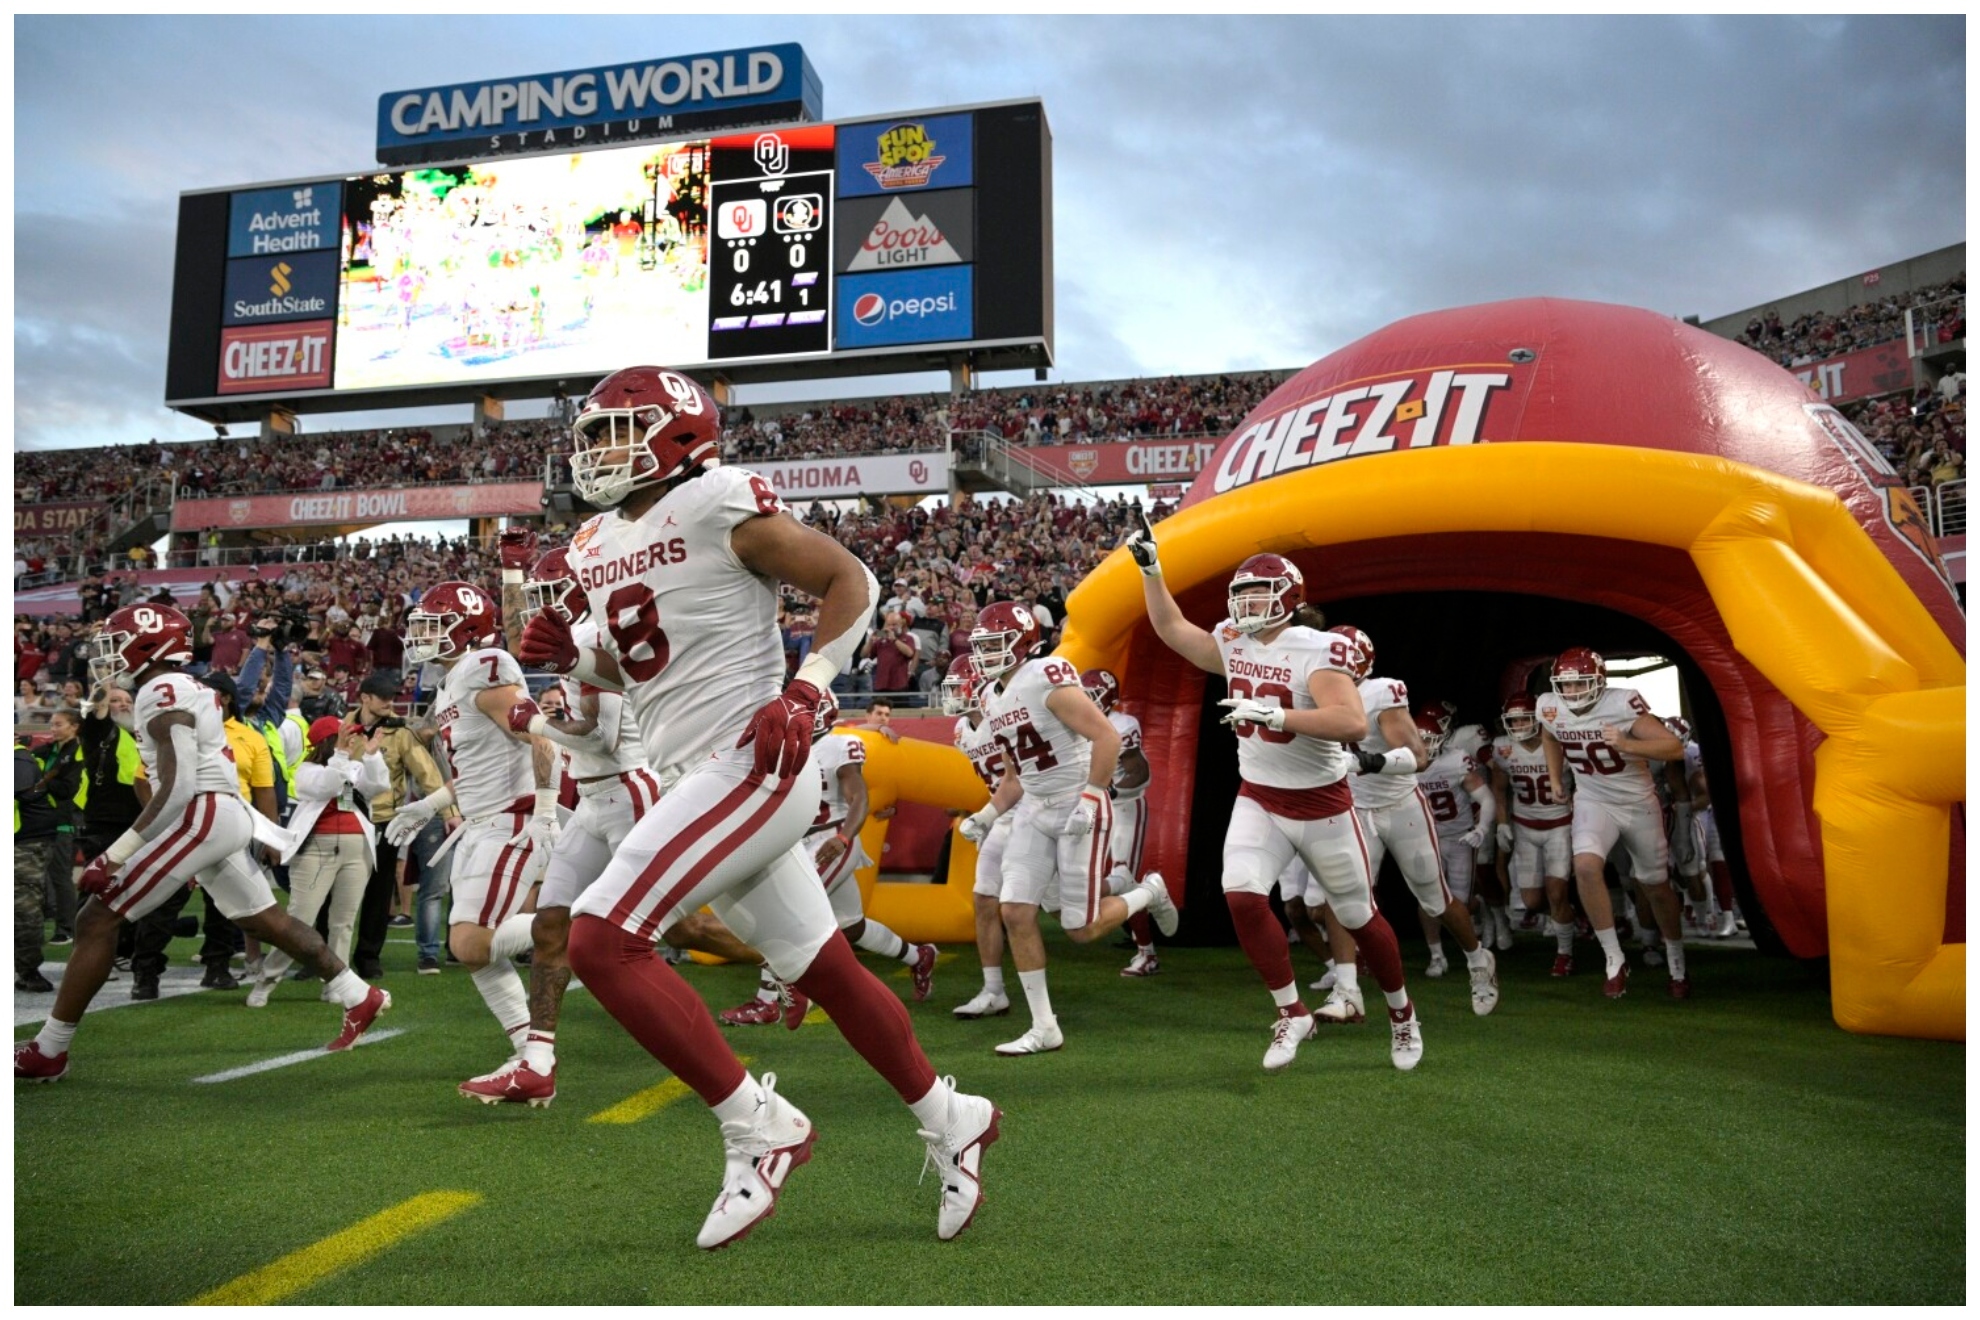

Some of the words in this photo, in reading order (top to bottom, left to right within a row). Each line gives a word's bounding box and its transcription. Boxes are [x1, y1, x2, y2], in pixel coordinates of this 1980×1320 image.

[390, 73, 598, 137] CAMPING
[604, 50, 784, 111] WORLD
[490, 115, 675, 149] STADIUM
[877, 124, 925, 153] FUN
[881, 140, 937, 168] SPOT
[880, 164, 931, 179] AMERICA
[249, 207, 321, 233] Advent
[253, 231, 320, 254] Health
[863, 220, 945, 251] Coors
[733, 248, 750, 273] 0
[789, 243, 806, 268] 0
[877, 247, 929, 265] LIGHT
[730, 279, 782, 306] 6:41
[799, 288, 809, 306] 1
[889, 291, 955, 320] pepsi
[233, 295, 325, 319] SouthState
[42, 506, 99, 529] STAT
[357, 492, 408, 518] BOWL
[581, 537, 687, 592] SOONERS
[605, 582, 670, 684] 8
[478, 655, 500, 683] 7
[1044, 661, 1078, 685] 84
[1228, 658, 1292, 684] SOONERS
[152, 682, 177, 709] 3
[1561, 740, 1626, 776] 50
